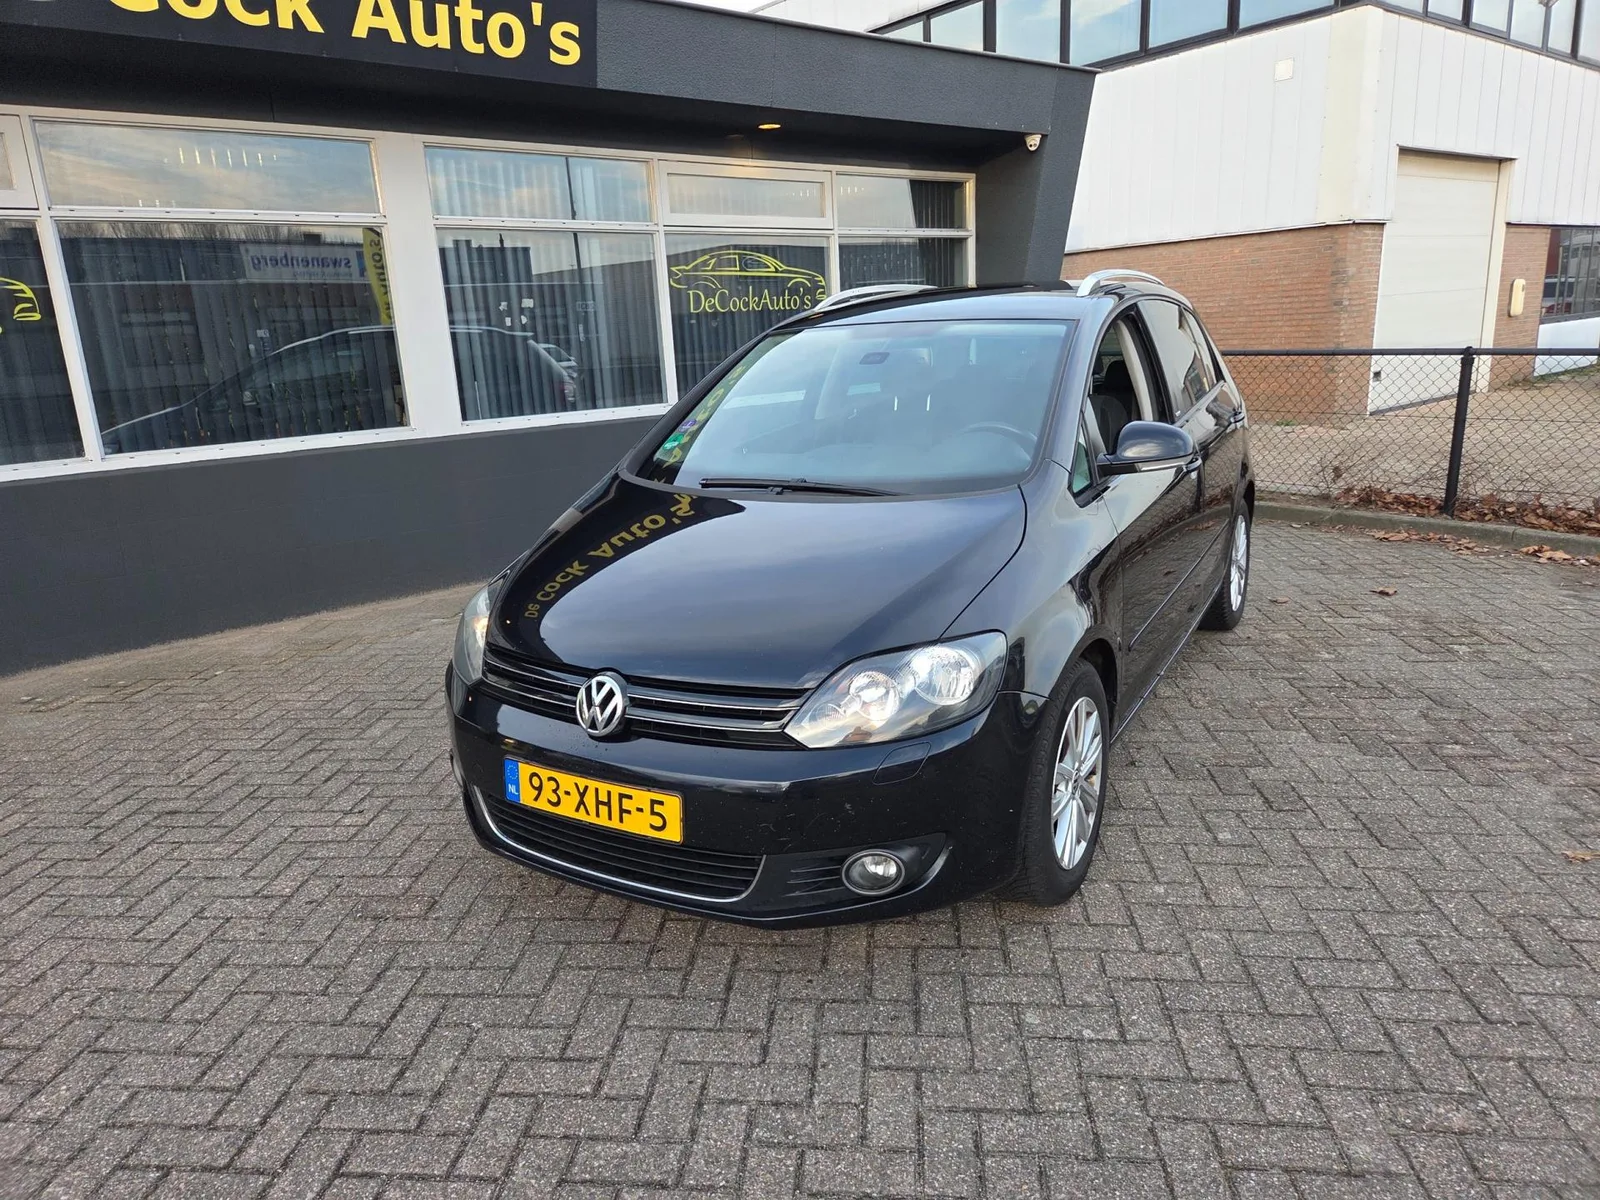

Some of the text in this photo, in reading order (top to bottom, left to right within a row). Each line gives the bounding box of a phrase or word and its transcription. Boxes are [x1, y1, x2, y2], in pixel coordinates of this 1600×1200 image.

[351, 0, 581, 66] Auto's
[687, 286, 812, 313] DeCockAuto's
[508, 771, 667, 832] NL 93-XHF-5
